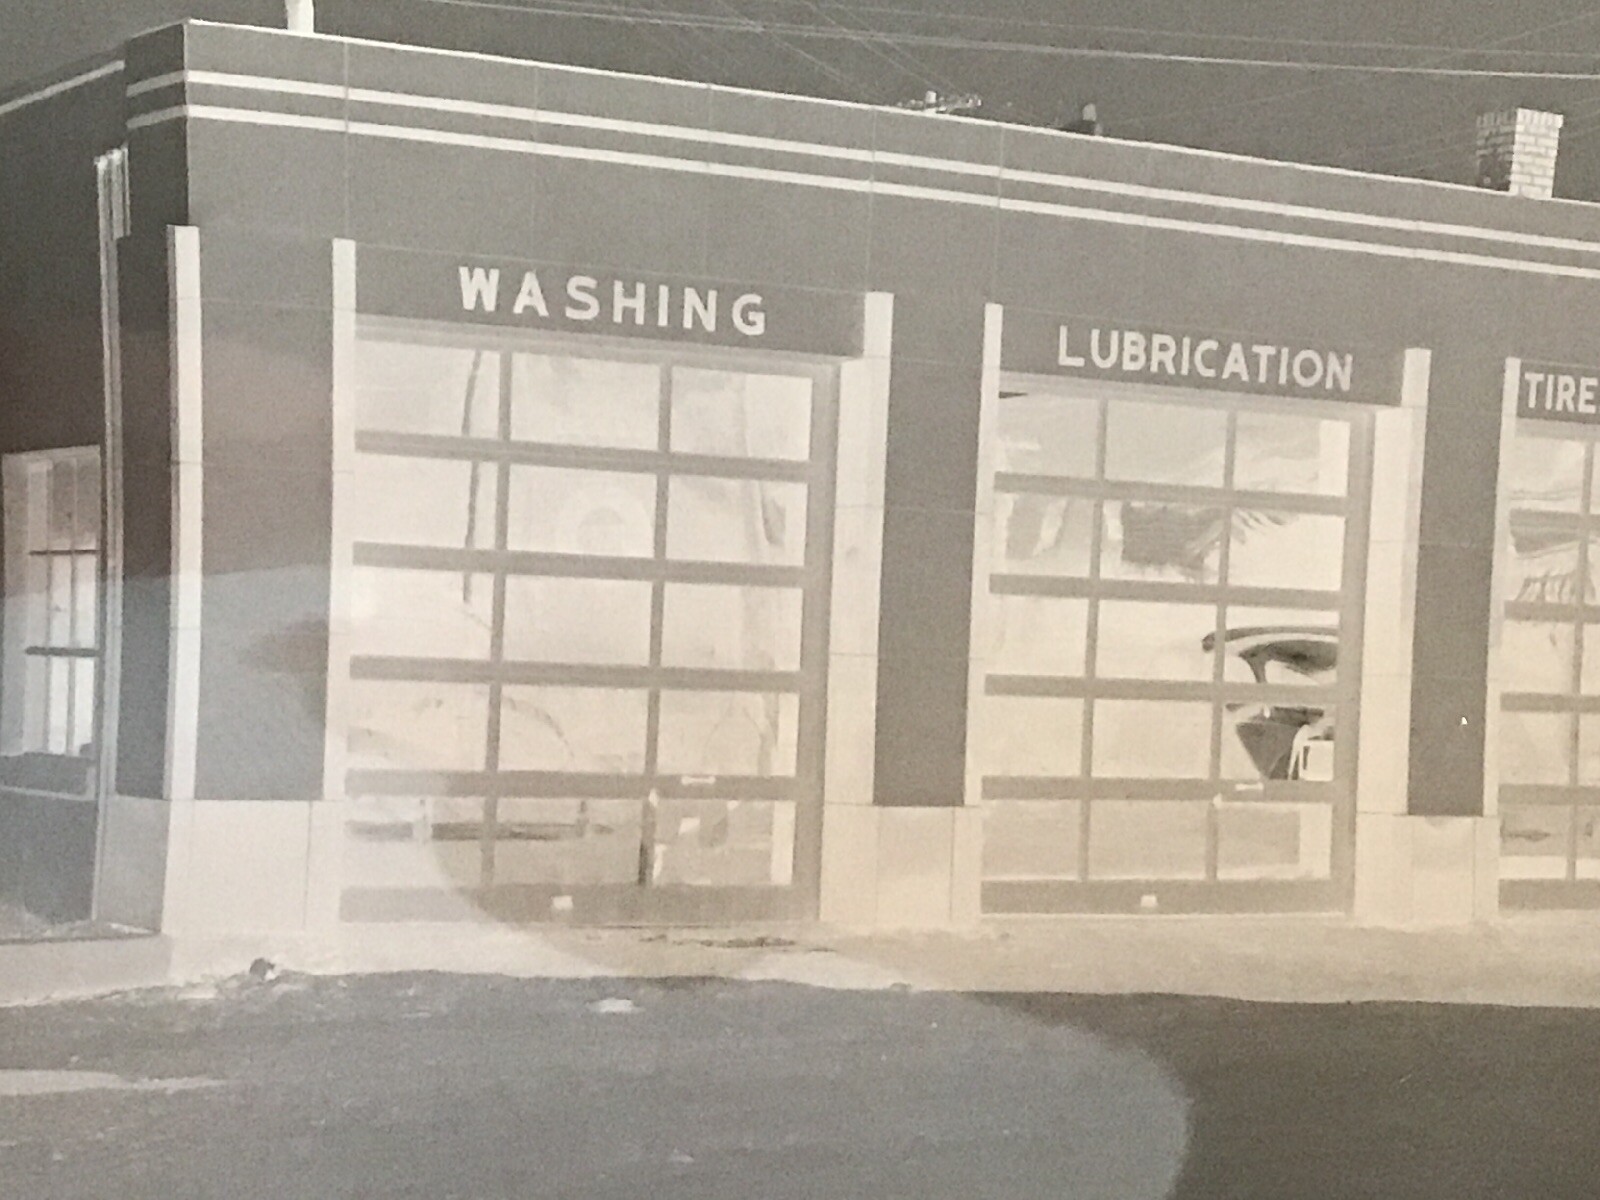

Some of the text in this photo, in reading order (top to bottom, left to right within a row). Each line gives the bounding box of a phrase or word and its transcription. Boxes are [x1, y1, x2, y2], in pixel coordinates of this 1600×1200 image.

[458, 266, 766, 336] WASHING
[1058, 325, 1353, 391] LUBRICATION
[1524, 372, 1598, 413] TIRE
